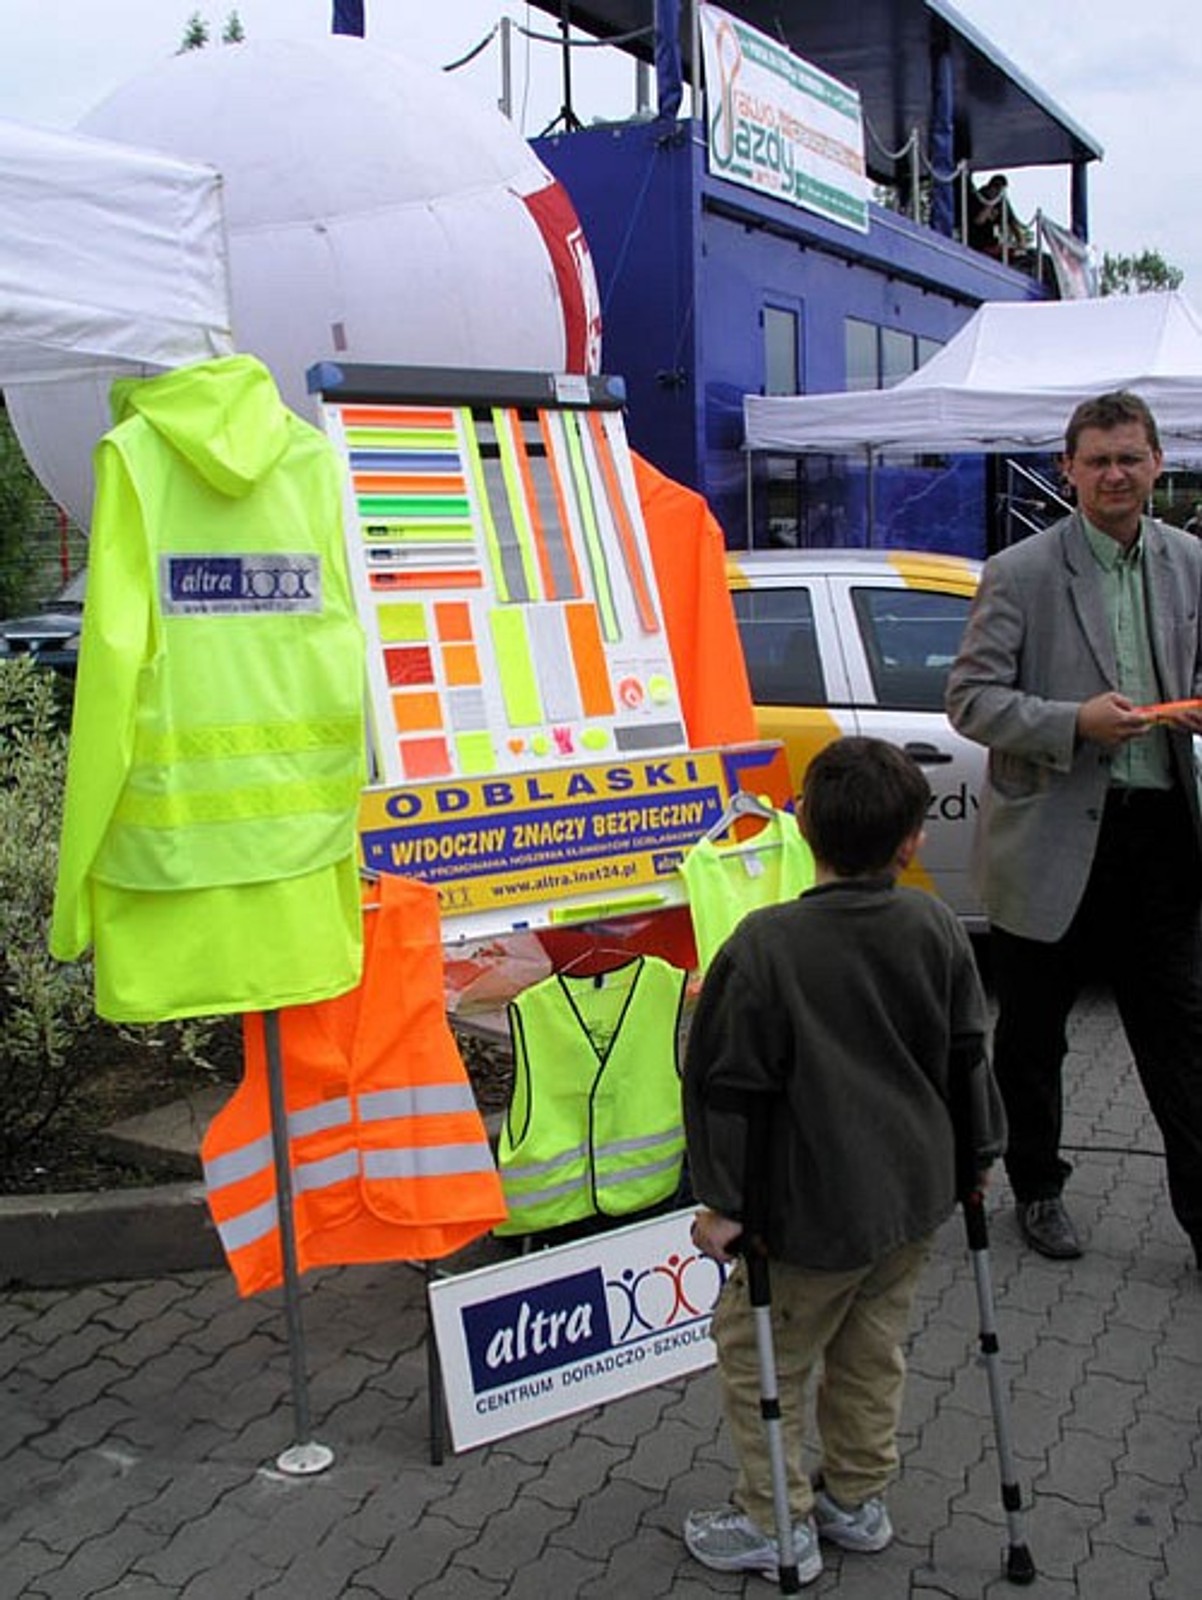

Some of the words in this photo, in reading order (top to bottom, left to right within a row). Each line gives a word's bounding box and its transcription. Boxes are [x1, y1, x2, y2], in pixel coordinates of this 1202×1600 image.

[181, 566, 233, 593] altra
[385, 760, 698, 819] ODBLASKI
[512, 815, 586, 849] ZNACZY
[485, 1301, 593, 1369] altra
[475, 1378, 554, 1415] CENTRUM
[561, 1325, 710, 1387] DORADCZO-SZKOLE
